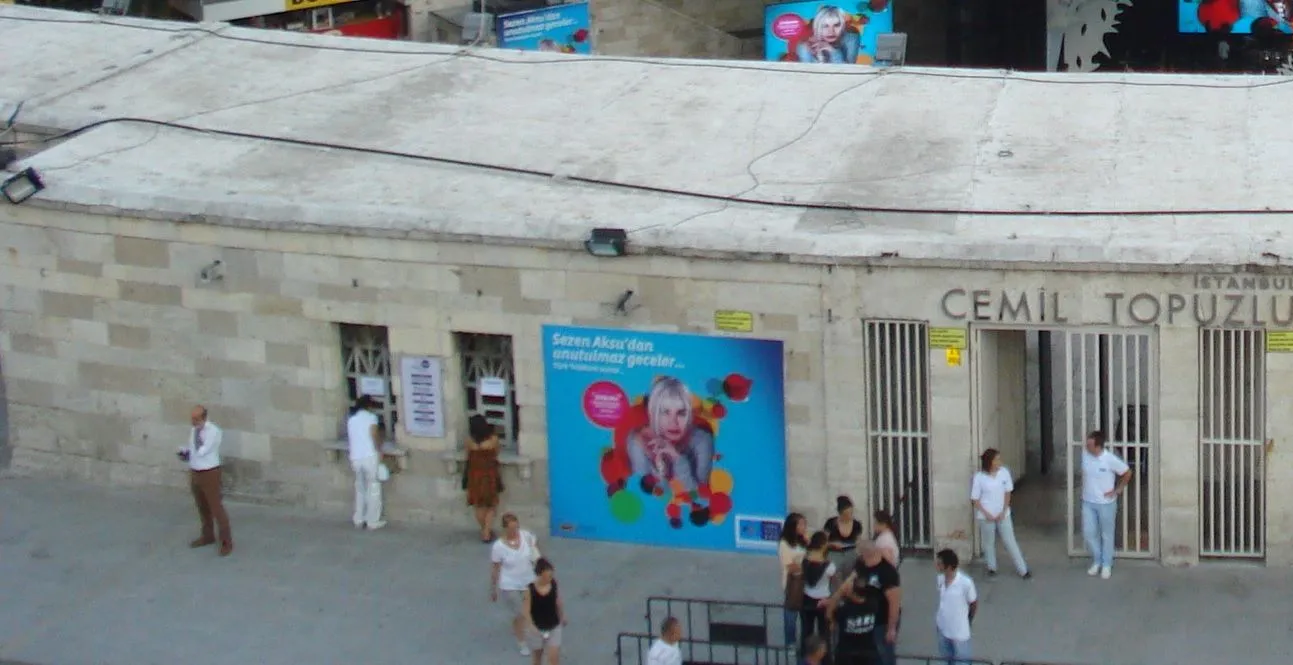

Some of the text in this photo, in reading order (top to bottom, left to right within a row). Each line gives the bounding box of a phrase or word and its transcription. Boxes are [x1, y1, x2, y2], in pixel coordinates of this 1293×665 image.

[941, 287, 1068, 321] CEMİL
[552, 332, 654, 352] Sezen Aksu'dan
[552, 349, 625, 364] unutulmaz
